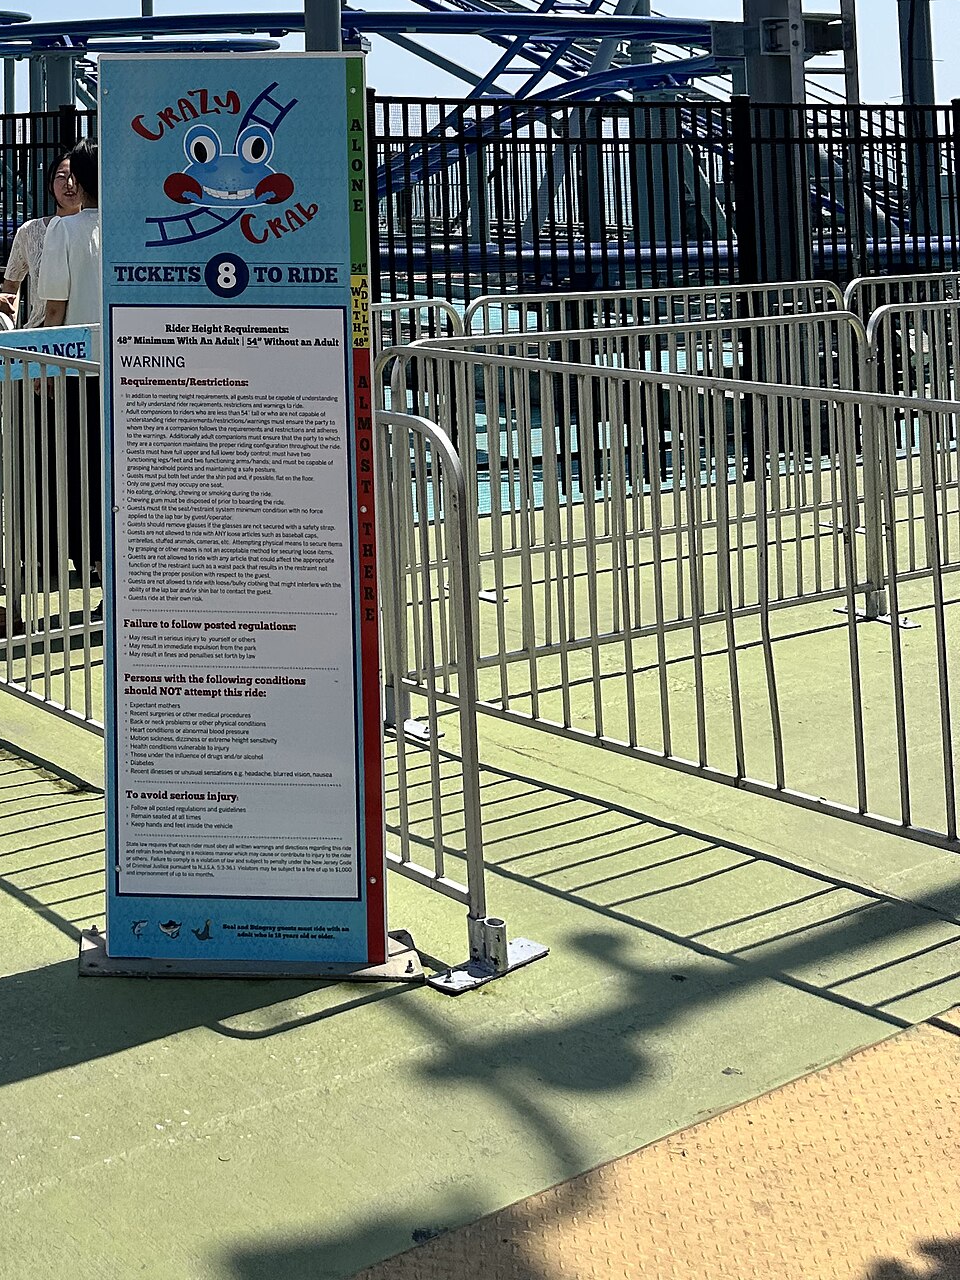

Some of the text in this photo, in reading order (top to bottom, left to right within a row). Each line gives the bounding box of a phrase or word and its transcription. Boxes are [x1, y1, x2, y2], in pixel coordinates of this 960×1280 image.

[350, 119, 364, 212] ALONE
[114, 262, 338, 289] TICKETS 8 TO RIDE
[350, 279, 370, 335] WITH ADULT
[165, 324, 289, 335] Rider Height Requirements:
[134, 336, 175, 344] Minimum
[177, 337, 198, 345] With
[200, 337, 213, 345] An
[215, 337, 240, 345] Adult
[263, 337, 299, 346] Without
[314, 337, 339, 347] Adult
[120, 355, 185, 368] WARNING
[120, 377, 249, 387] Requirements/Restrictions:
[357, 375, 375, 622] ALMOST THERE
[123, 619, 297, 632] Failure to follow posted regulations:
[124, 673, 306, 686] Persons with the following conditions
[124, 686, 267, 698] should NOT attempt this ride:
[126, 790, 239, 803] To avoid serious injury:
